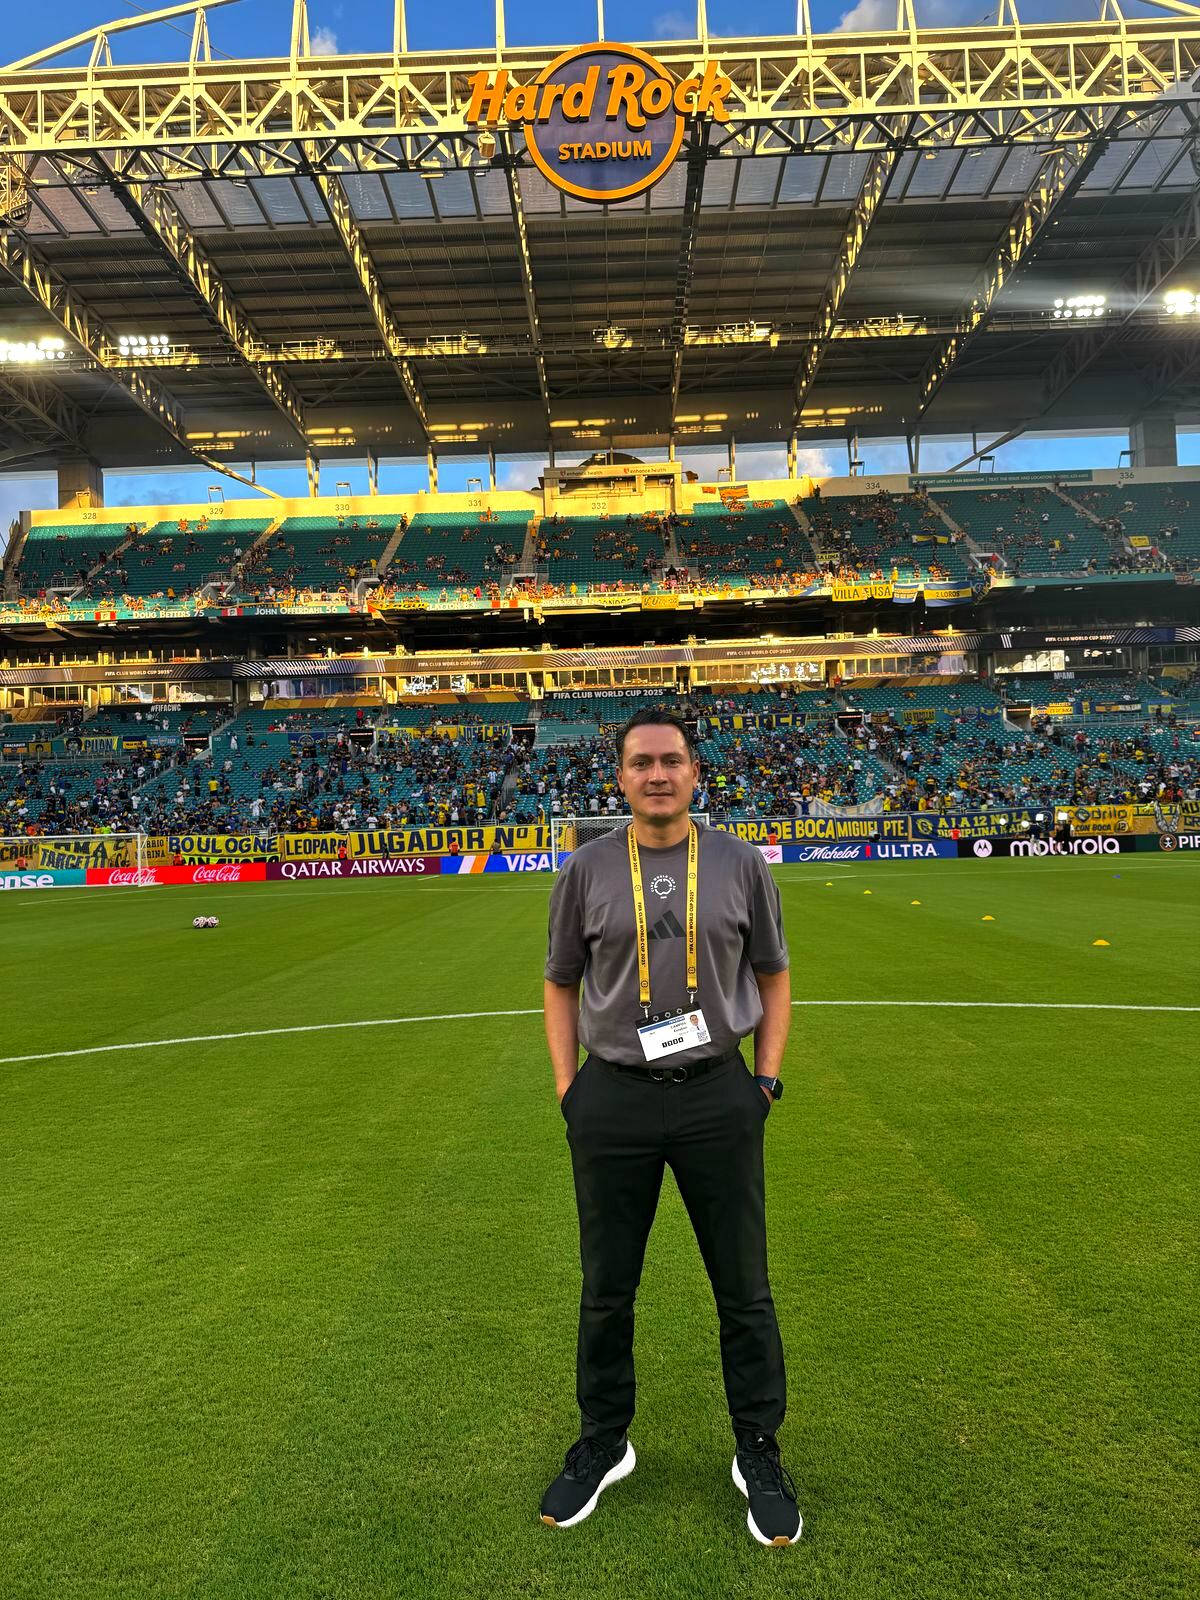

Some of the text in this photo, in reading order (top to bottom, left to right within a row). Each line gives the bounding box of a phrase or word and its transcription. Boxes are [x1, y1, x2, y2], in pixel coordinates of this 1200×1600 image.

[466, 61, 732, 132] Hard Rock
[558, 140, 652, 163] STADIUM
[1119, 472, 1135, 480] 336
[865, 481, 880, 490] 334
[335, 503, 350, 511] 330
[468, 499, 482, 507] 331
[591, 502, 607, 510] 332
[82, 512, 97, 520] 328
[209, 507, 224, 516] 329
[834, 588, 860, 600] VILLA
[133, 608, 205, 620] DOUG BETTERS 75
[255, 604, 337, 616] JOHN OFFERDAHL 56
[74, 612, 86, 621] 73
[553, 692, 570, 700] FIFA
[572, 691, 593, 699] CLUB
[594, 690, 624, 698] WORLD
[625, 689, 642, 697] CUP
[150, 704, 182, 712] #FIFACWC
[973, 815, 988, 827] 12
[795, 819, 836, 840] BOCA
[837, 820, 878, 838] MIGUEL
[168, 836, 279, 854] BOULOGNE
[354, 829, 485, 856] JUGADOR
[799, 843, 938, 861] Michelob ULTRA
[281, 858, 426, 880] QATAR AIRWAYS
[502, 854, 552, 872] VISA
